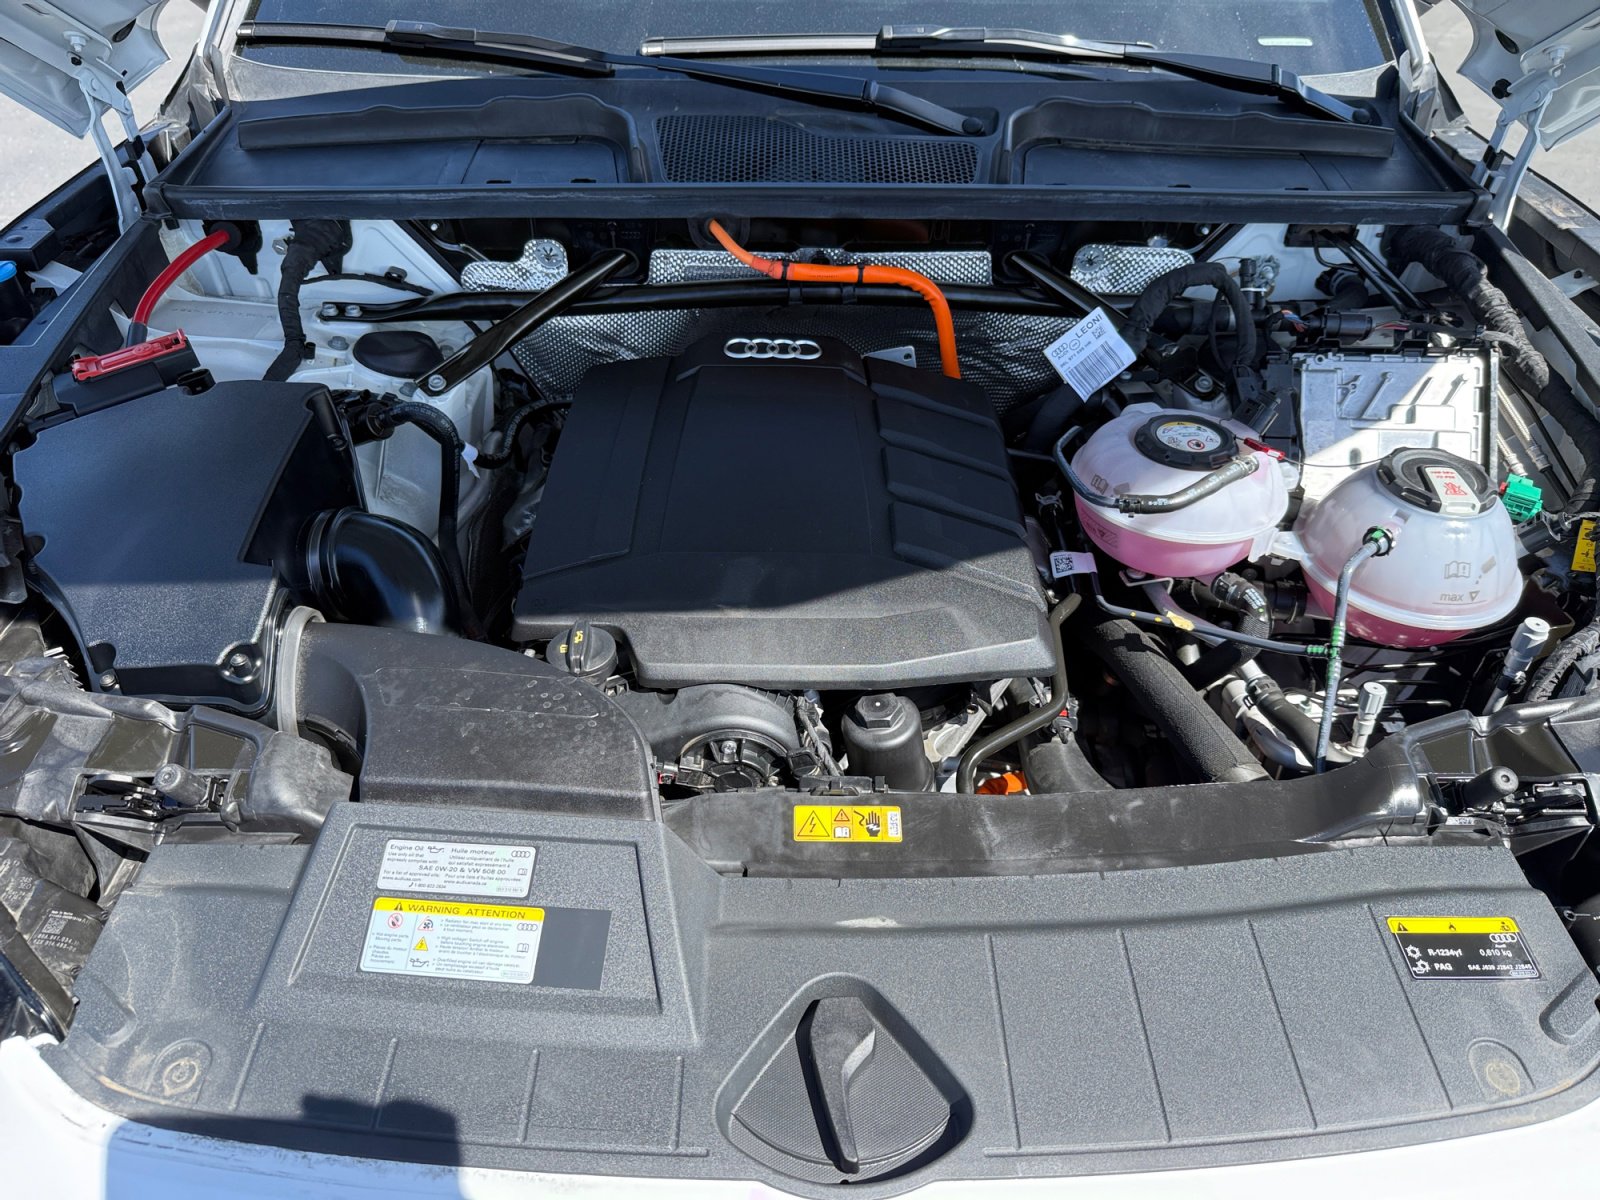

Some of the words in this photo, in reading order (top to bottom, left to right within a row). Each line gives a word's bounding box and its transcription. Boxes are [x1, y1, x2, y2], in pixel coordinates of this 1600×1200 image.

[1075, 314, 1102, 338] LEONI
[1440, 592, 1464, 602] max
[408, 904, 460, 915] WARNING
[465, 907, 526, 919] ATTENTION
[1428, 948, 1463, 958] R-1234yf
[1501, 949, 1512, 958] kg
[1434, 963, 1452, 971] PAG
